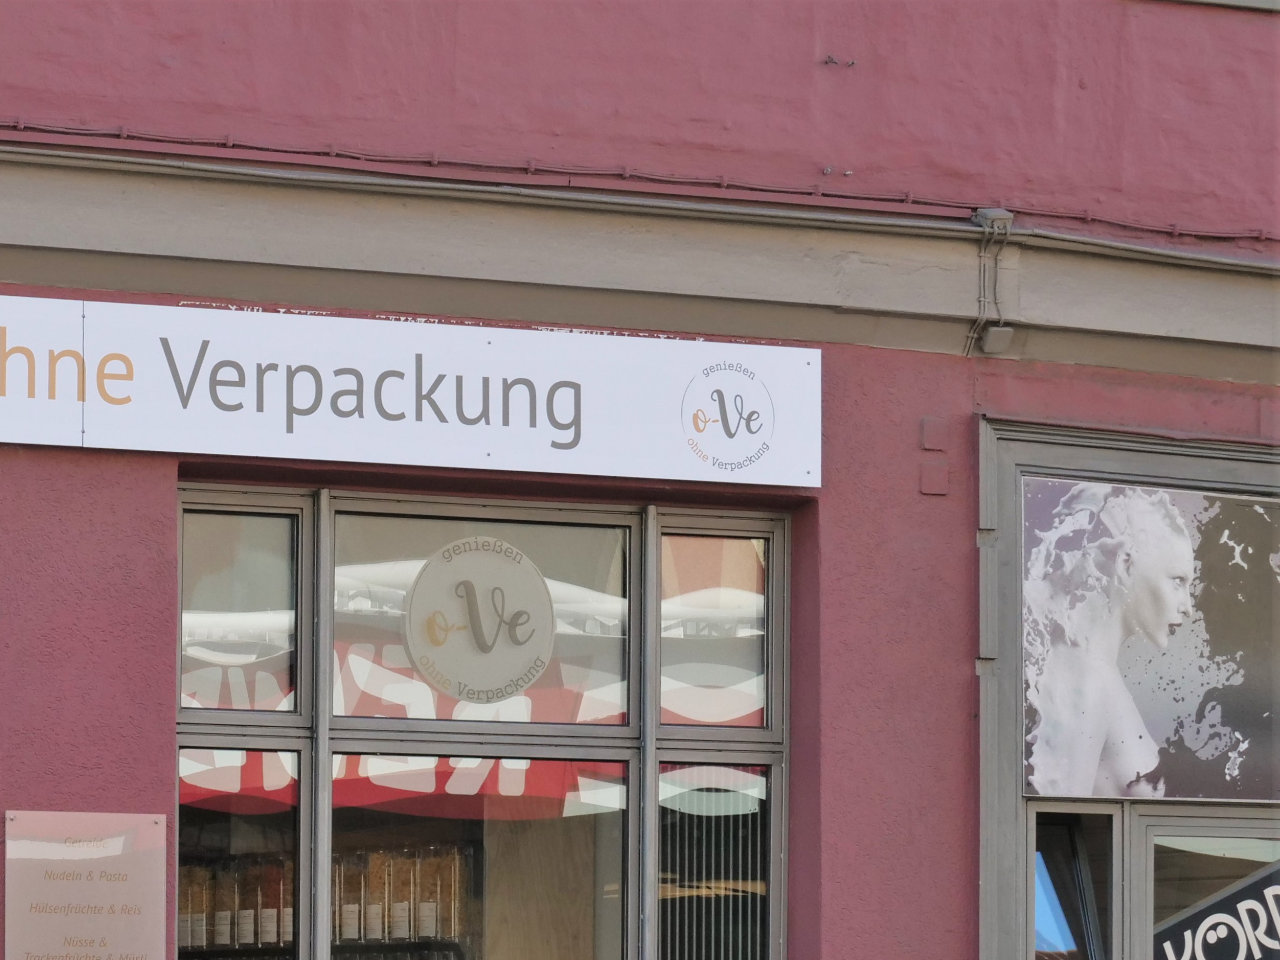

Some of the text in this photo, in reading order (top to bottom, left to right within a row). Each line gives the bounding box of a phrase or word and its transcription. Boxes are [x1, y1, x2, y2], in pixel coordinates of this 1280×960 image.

[702, 361, 756, 380] genießen
[158, 337, 583, 450] Verpackung
[687, 438, 770, 471] ohne Verpackung
[442, 537, 524, 565] genießen
[419, 655, 546, 702] ohne Verpackung
[43, 870, 129, 883] Nudeln & Pasta
[29, 903, 142, 917] Hülsenfrüchte & Reis
[63, 936, 108, 948] Nüsse &
